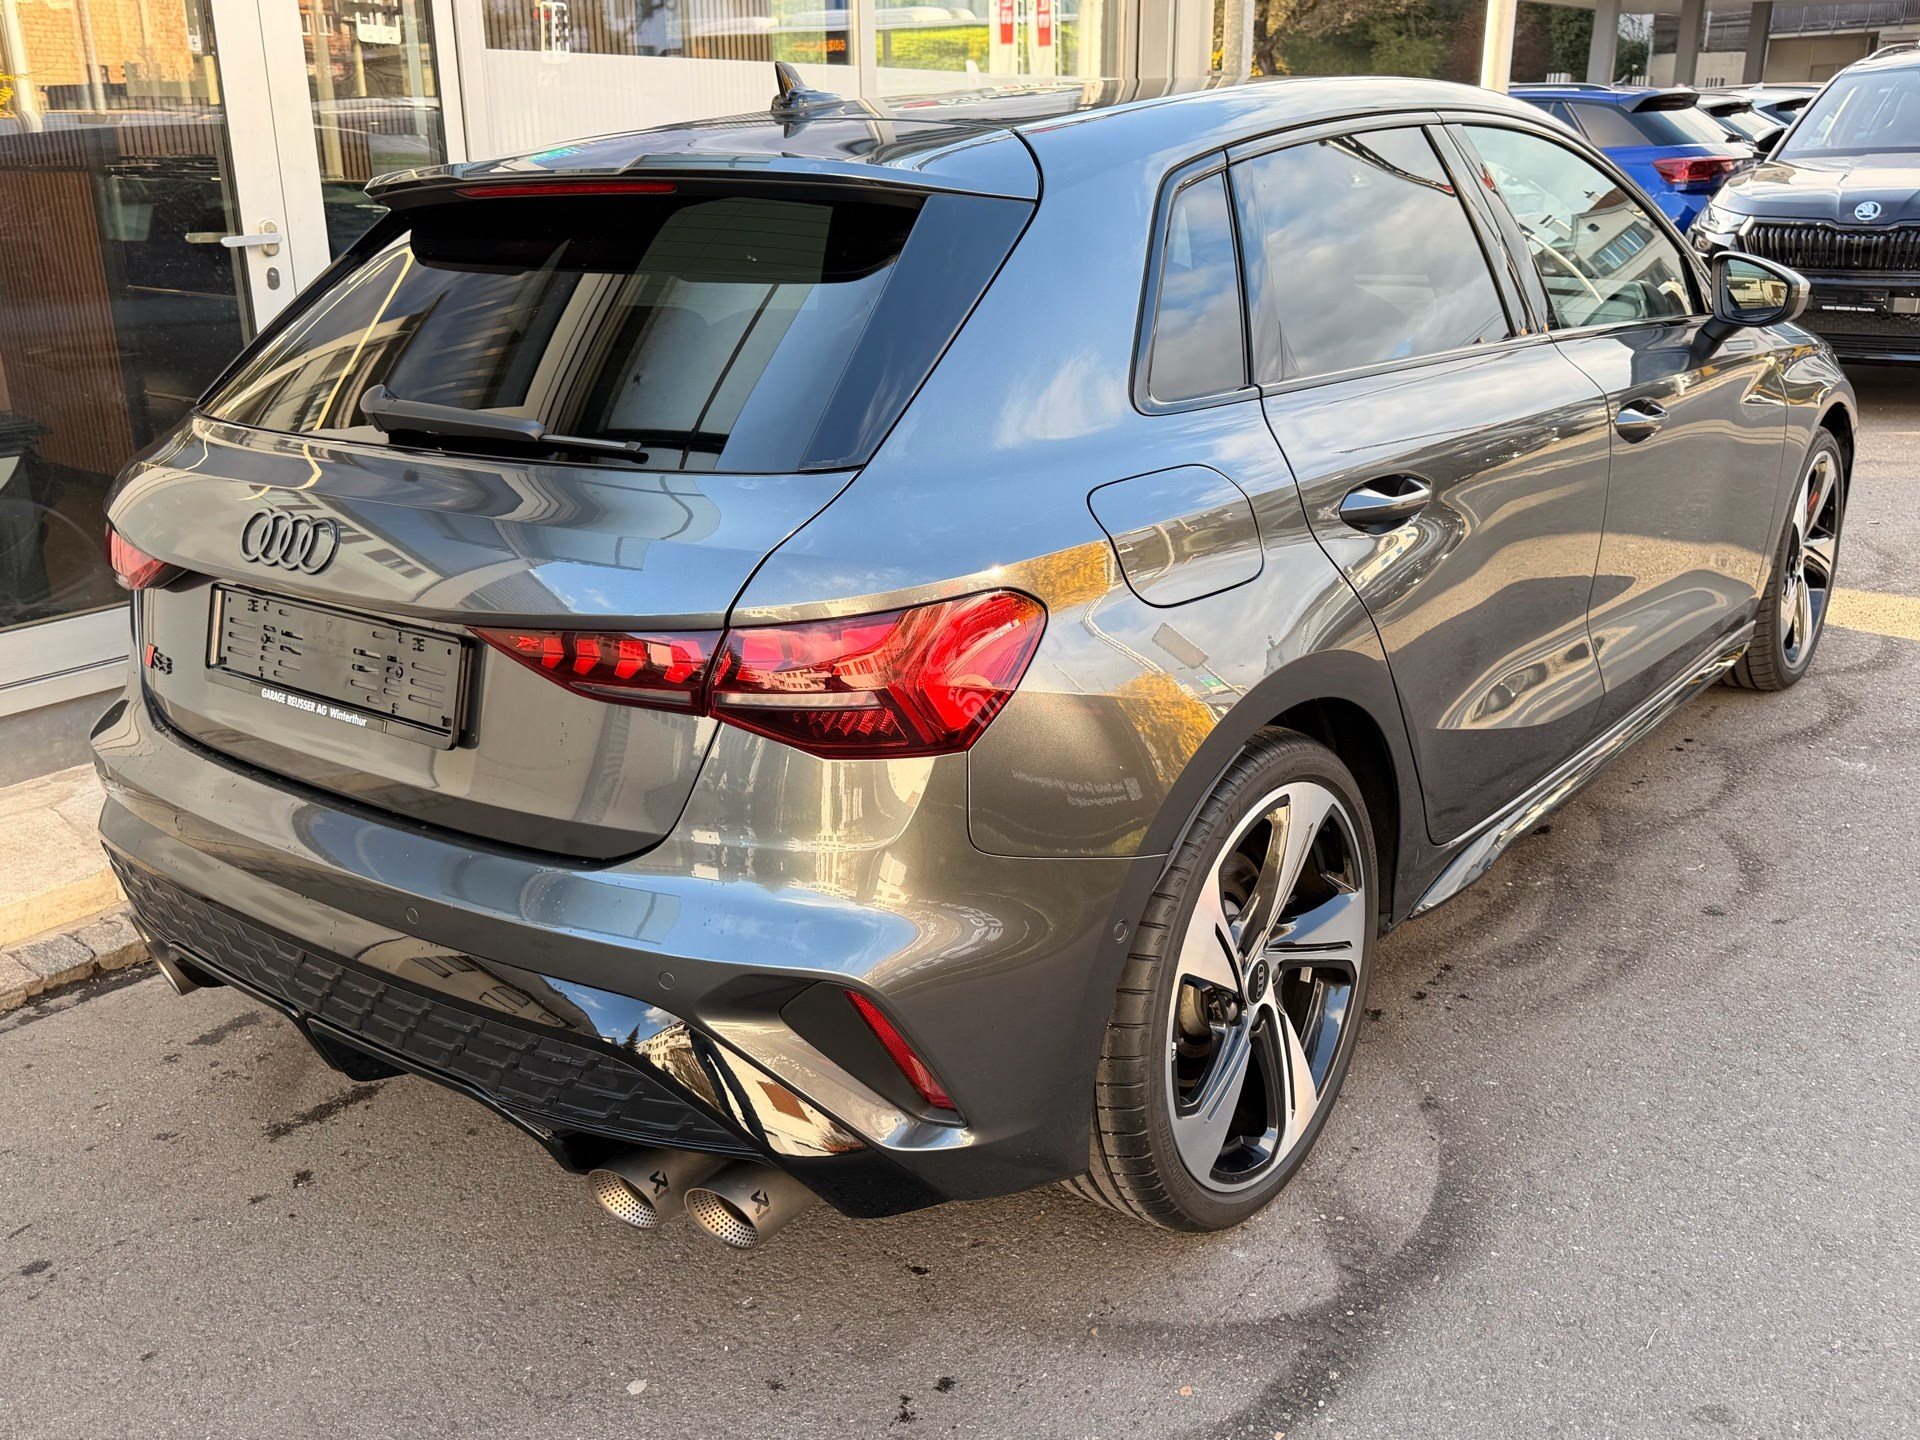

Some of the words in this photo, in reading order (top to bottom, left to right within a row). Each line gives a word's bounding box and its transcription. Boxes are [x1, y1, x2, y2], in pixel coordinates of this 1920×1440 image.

[261, 687, 286, 703] GARAGE
[287, 695, 315, 712] REUSSER
[316, 703, 328, 715] AG
[329, 707, 367, 727] Winterthur
